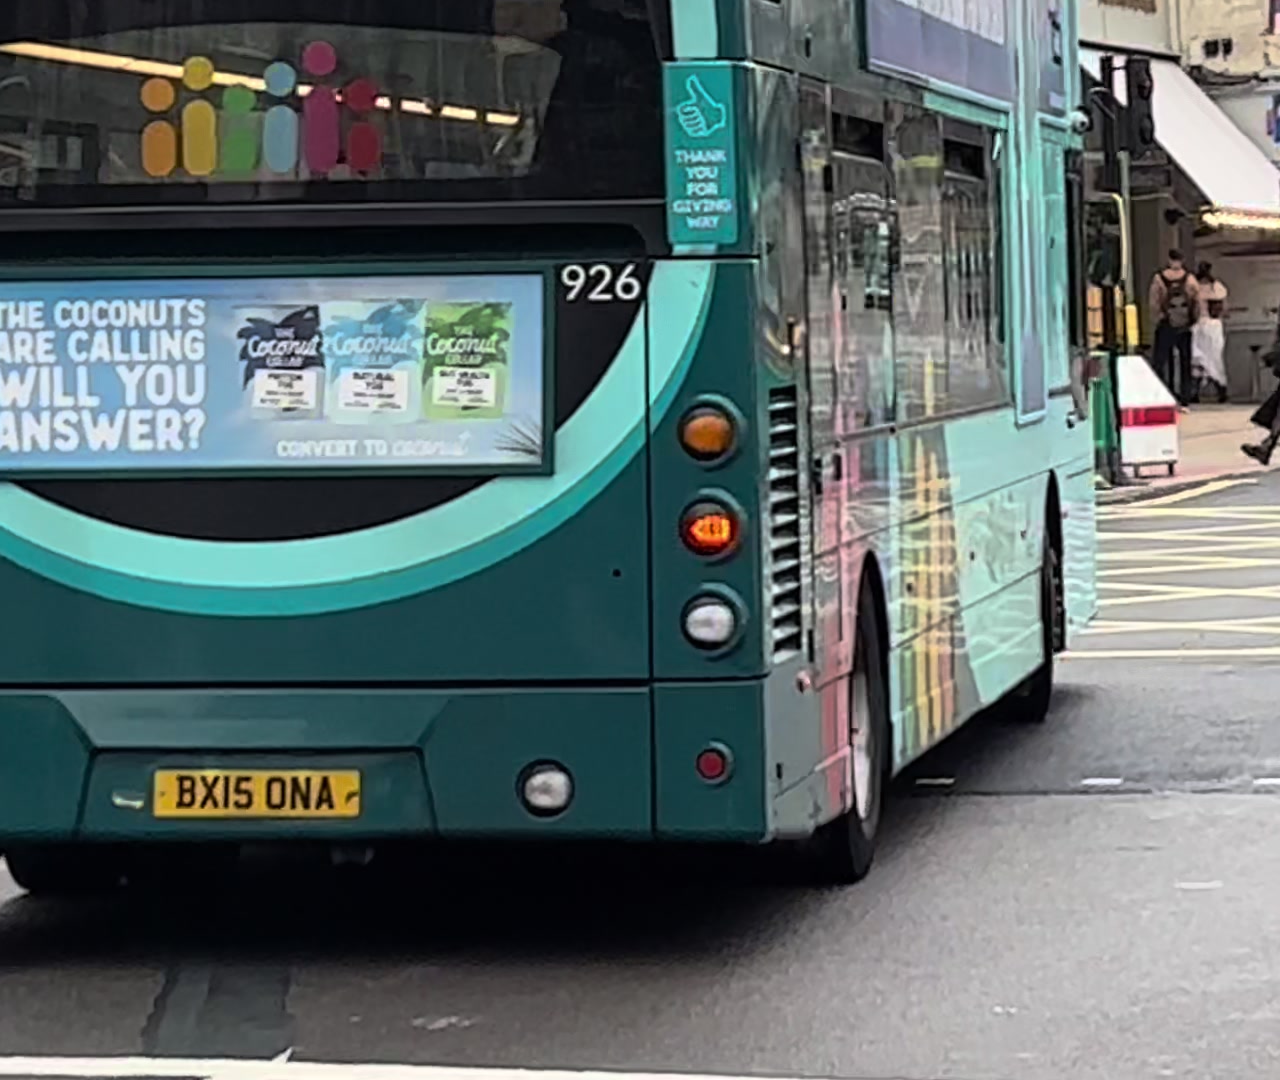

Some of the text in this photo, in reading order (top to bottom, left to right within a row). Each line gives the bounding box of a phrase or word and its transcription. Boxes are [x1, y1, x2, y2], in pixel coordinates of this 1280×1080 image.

[675, 150, 727, 164] THANK
[686, 166, 718, 180] YOU
[687, 181, 719, 196] FOR
[673, 199, 732, 214] GIVING
[561, 263, 642, 301] 926
[54, 298, 206, 328] COCONUTS
[68, 328, 205, 363] CALLING
[247, 334, 320, 358] Coconut
[333, 330, 410, 356] Coconut
[427, 332, 497, 356] Coconut
[116, 363, 206, 406] YOU
[276, 439, 358, 458] CONVERT
[363, 439, 388, 456] TO
[175, 775, 334, 810] BX15 ONA
